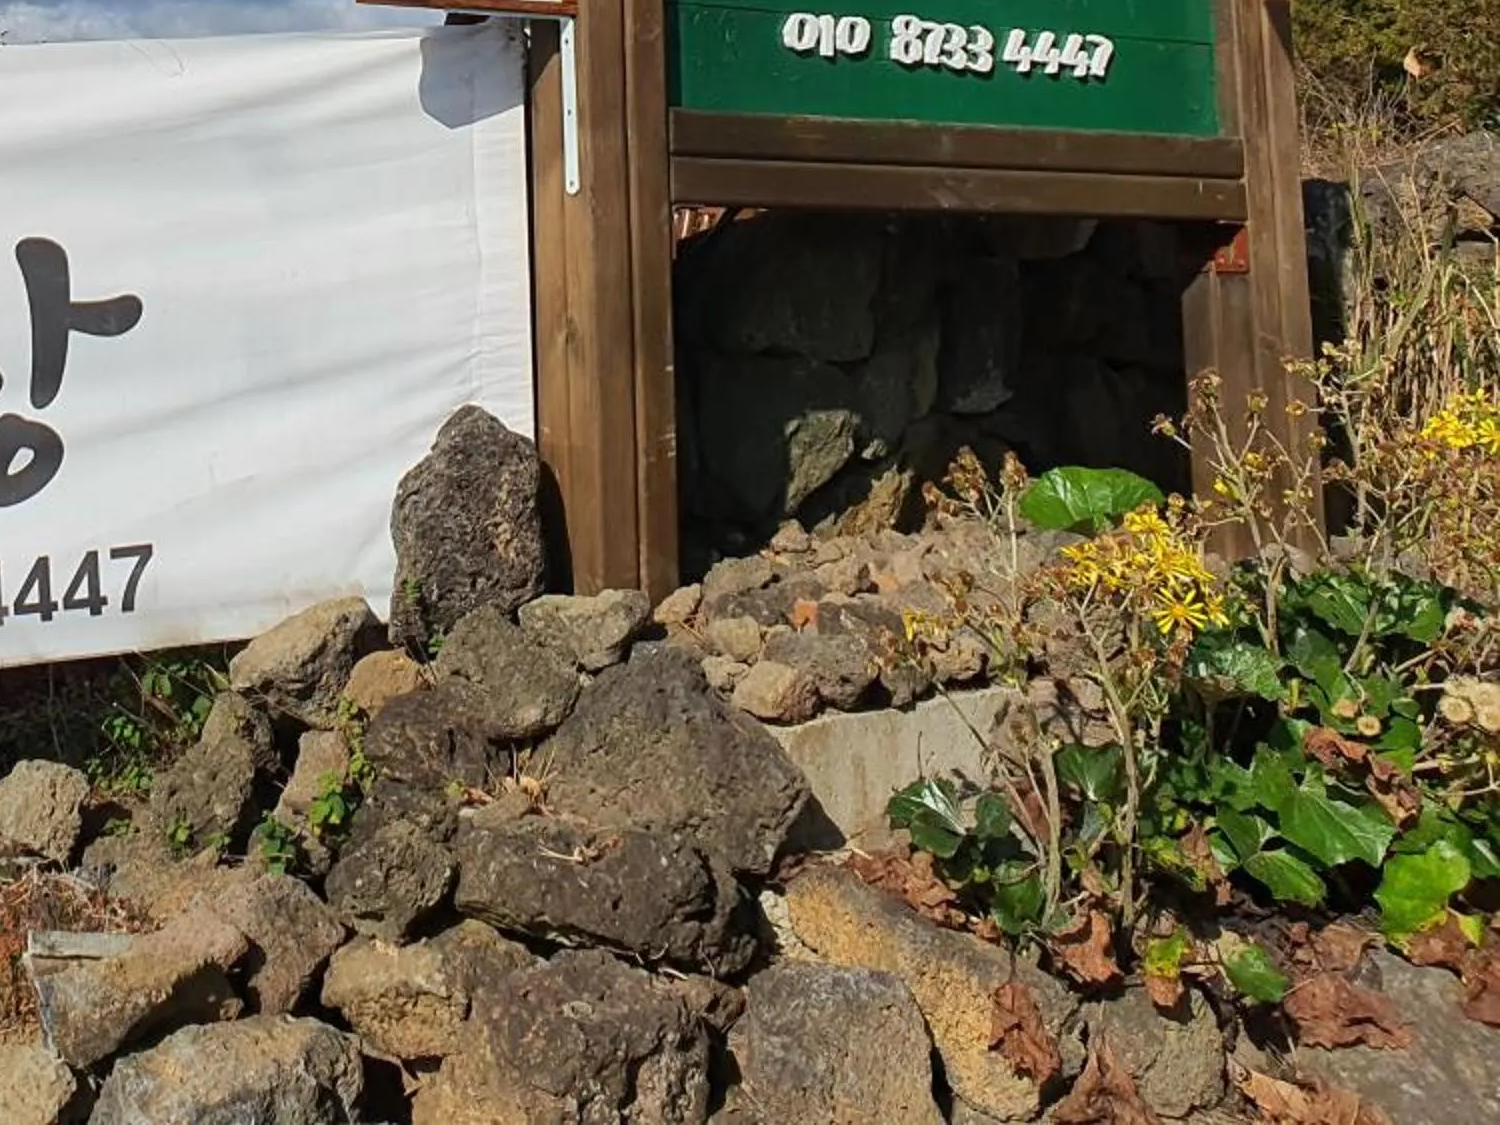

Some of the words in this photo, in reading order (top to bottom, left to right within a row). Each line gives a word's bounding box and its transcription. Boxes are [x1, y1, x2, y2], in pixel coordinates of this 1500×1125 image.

[781, 12, 871, 57] 010
[889, 14, 995, 73] 8733
[1002, 27, 1115, 77] 4447
